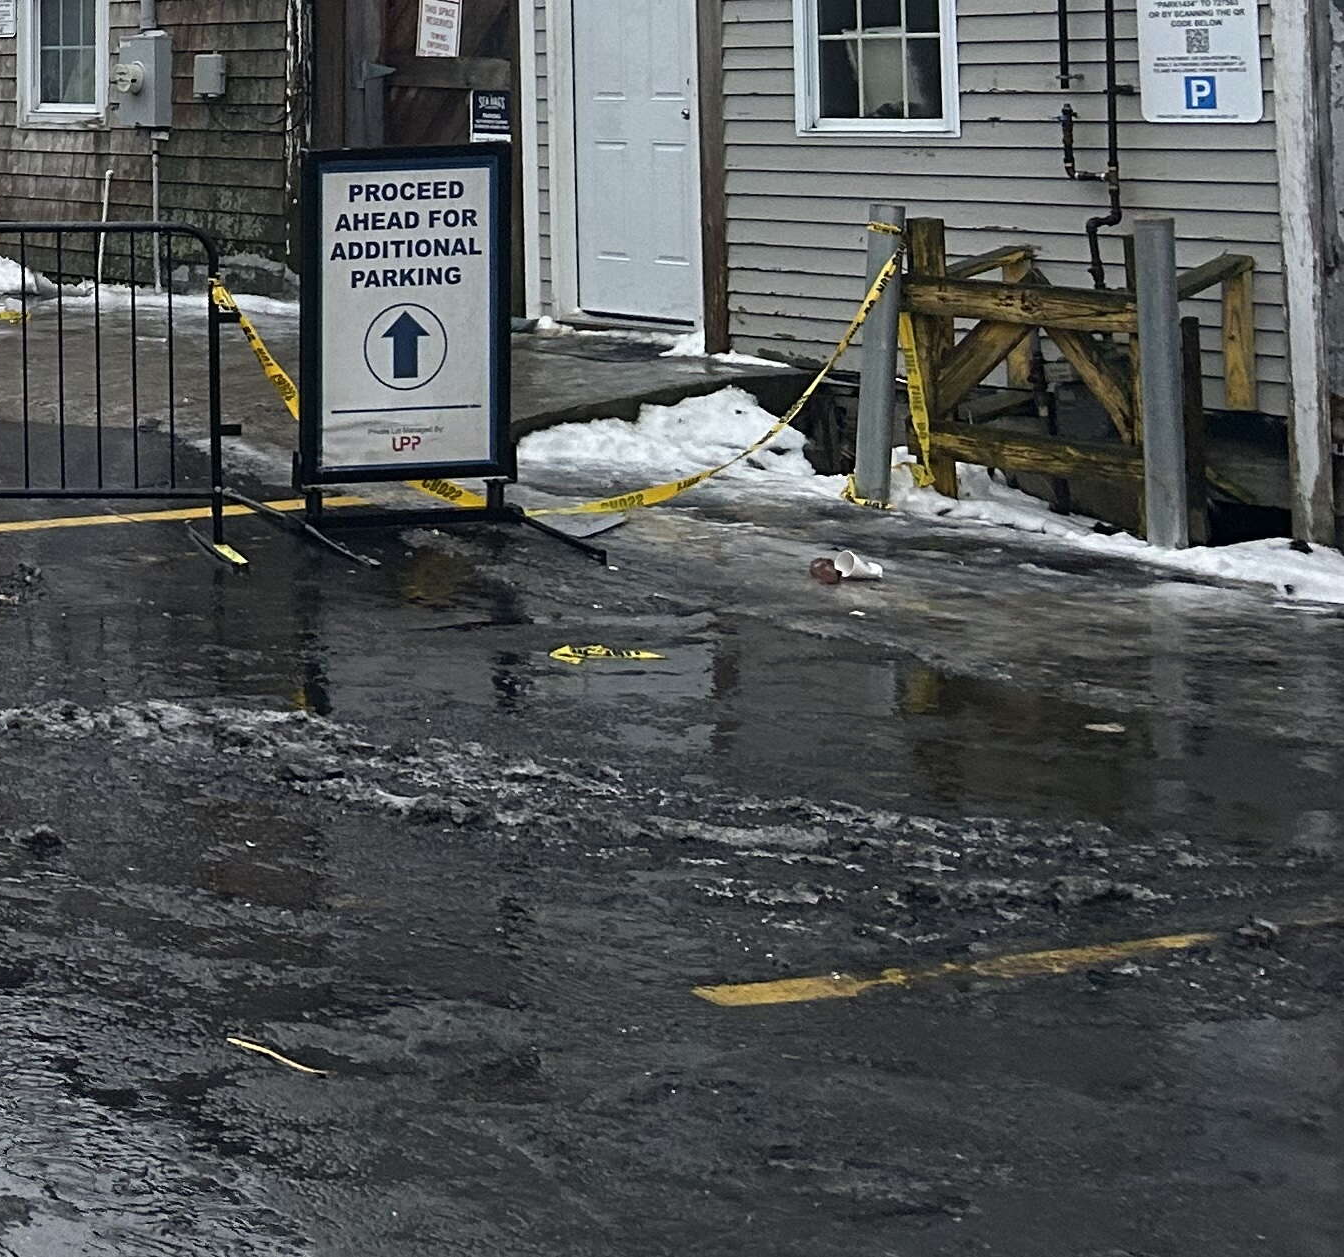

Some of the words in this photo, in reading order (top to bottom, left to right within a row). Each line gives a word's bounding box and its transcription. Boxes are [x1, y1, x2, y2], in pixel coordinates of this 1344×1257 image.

[1190, 79, 1211, 107] P
[348, 181, 465, 203] PROCEED
[334, 211, 420, 232] AHEAD
[428, 209, 478, 229] FOR
[330, 238, 483, 262] ADDITIONAL
[350, 267, 462, 289] PARKING
